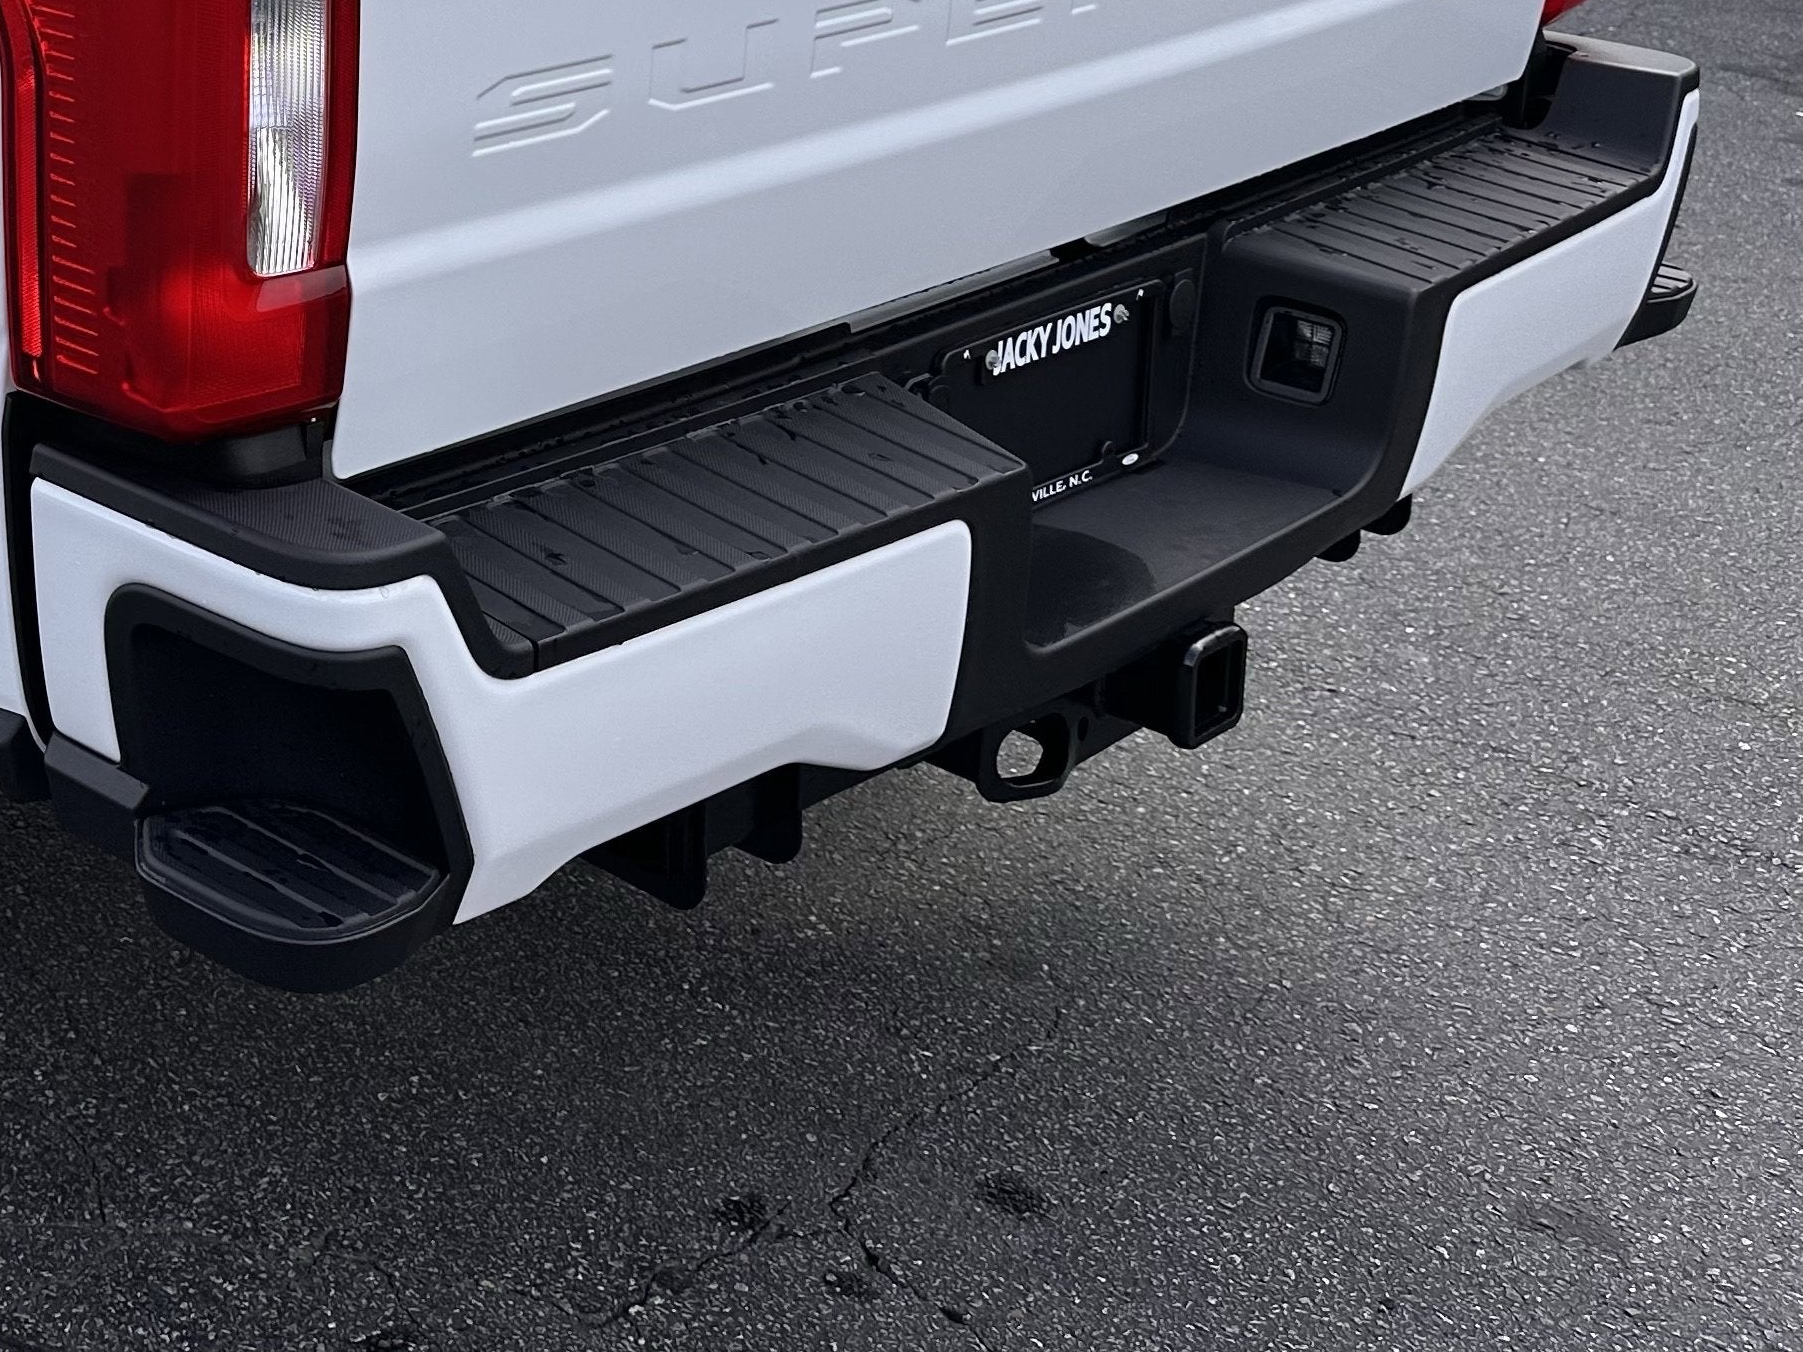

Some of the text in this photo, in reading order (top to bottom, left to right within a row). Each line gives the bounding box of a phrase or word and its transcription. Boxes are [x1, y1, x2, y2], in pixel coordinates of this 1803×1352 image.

[993, 302, 1112, 376] JACKY JONES
[1069, 470, 1093, 488] N.C.
